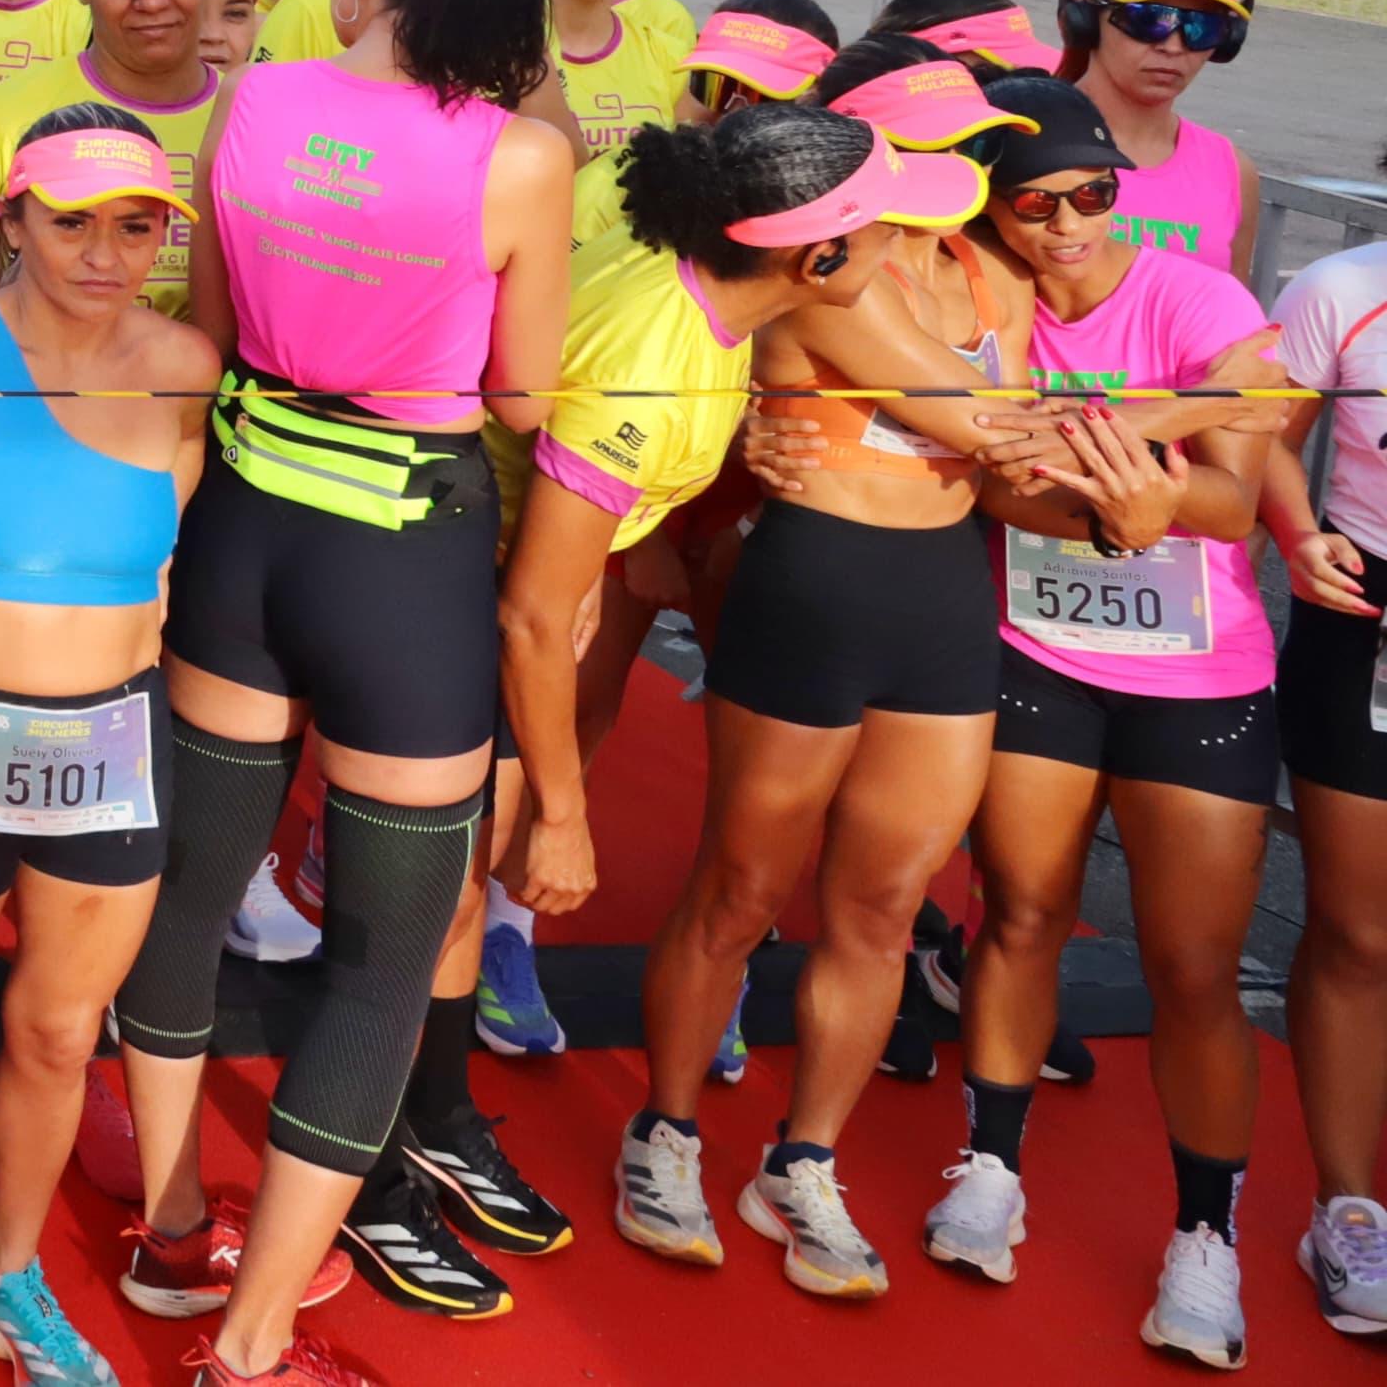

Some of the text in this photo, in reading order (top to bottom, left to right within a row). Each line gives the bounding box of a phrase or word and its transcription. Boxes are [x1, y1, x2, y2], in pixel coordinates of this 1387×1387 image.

[75, 148, 152, 168] MULHERES
[77, 139, 141, 153] CIRCUITO
[305, 133, 376, 171] CITY
[293, 177, 363, 211] RUNNERS
[1107, 213, 1201, 253] CITY
[362, 244, 393, 260] MAIS
[591, 439, 640, 470] APARECIDA
[1043, 562, 1148, 582] Adriana Santos
[1035, 576, 1162, 629] 5250
[27, 727, 92, 738] MULHERES
[30, 719, 83, 730] CIRCUITO
[4, 760, 107, 808] 5101
